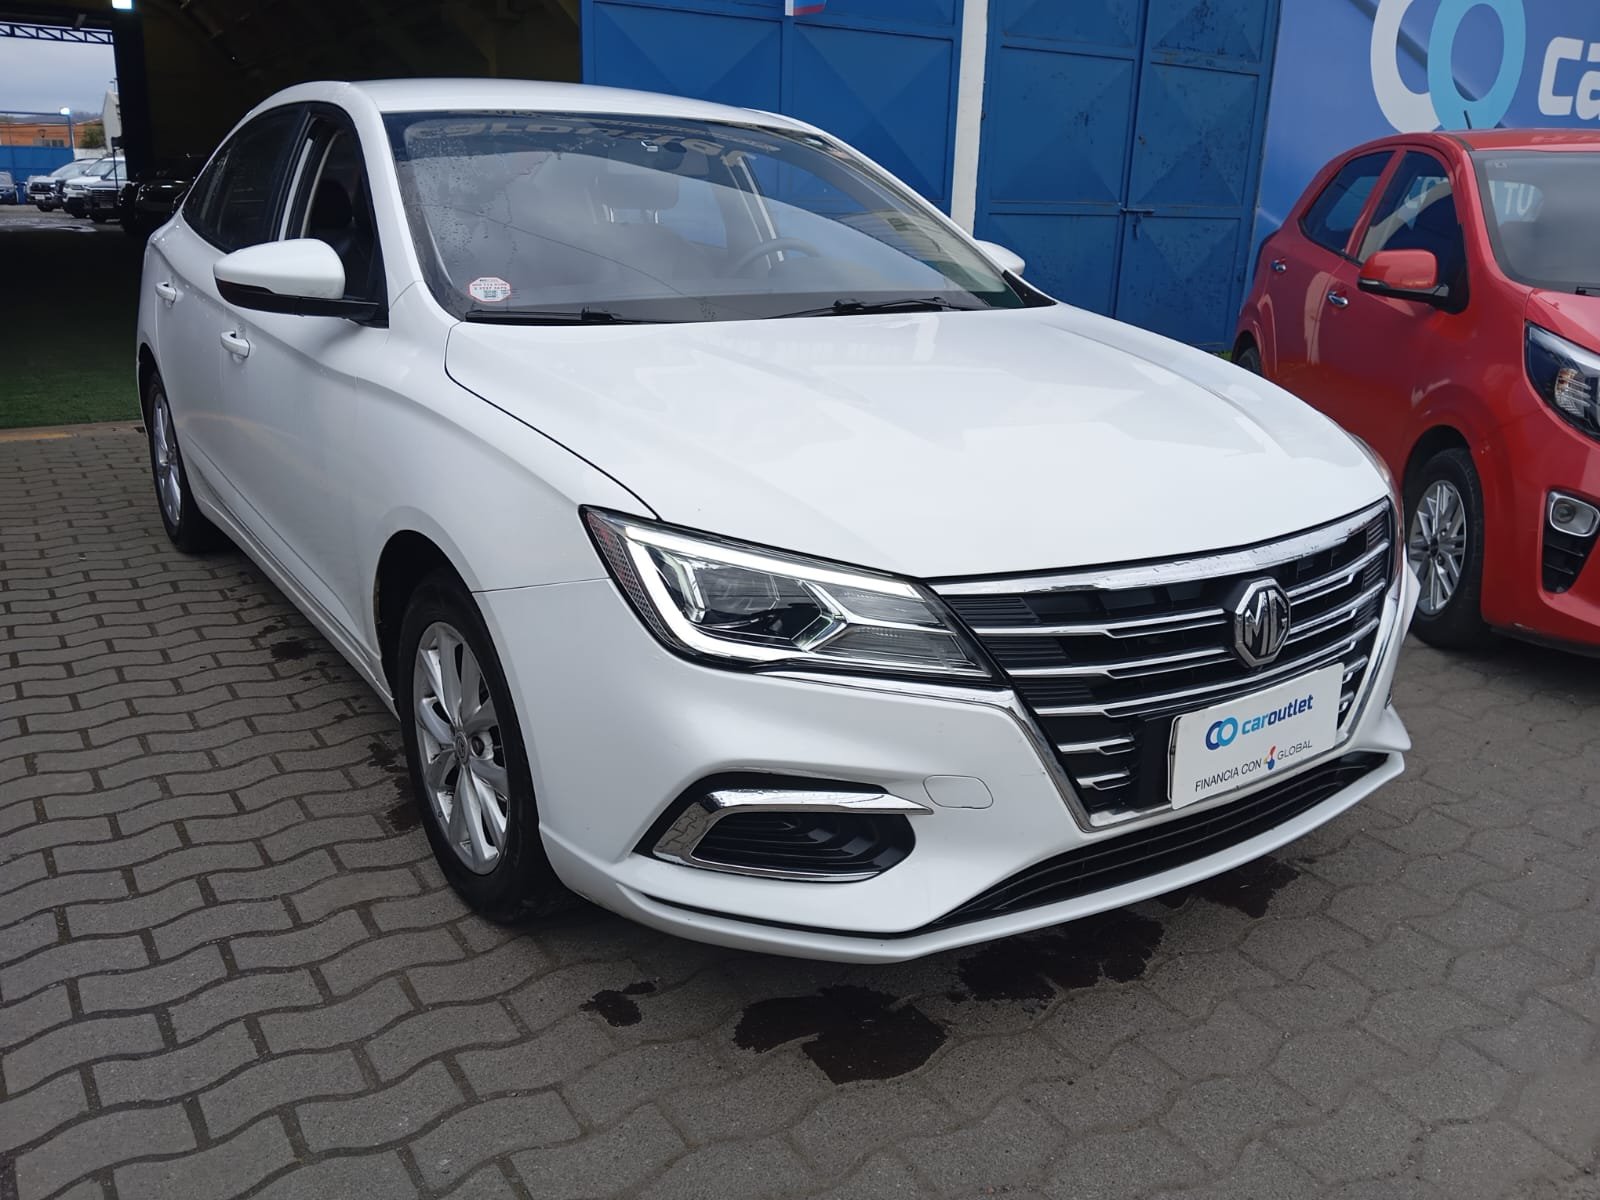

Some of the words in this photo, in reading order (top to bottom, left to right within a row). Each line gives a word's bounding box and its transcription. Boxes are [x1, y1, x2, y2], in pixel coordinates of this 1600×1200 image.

[1244, 589, 1288, 656] MG
[1241, 694, 1313, 735] caroutlet
[1195, 767, 1239, 792] FINANCIA
[1241, 758, 1262, 775] CON
[1277, 740, 1313, 760] GLOBAL
